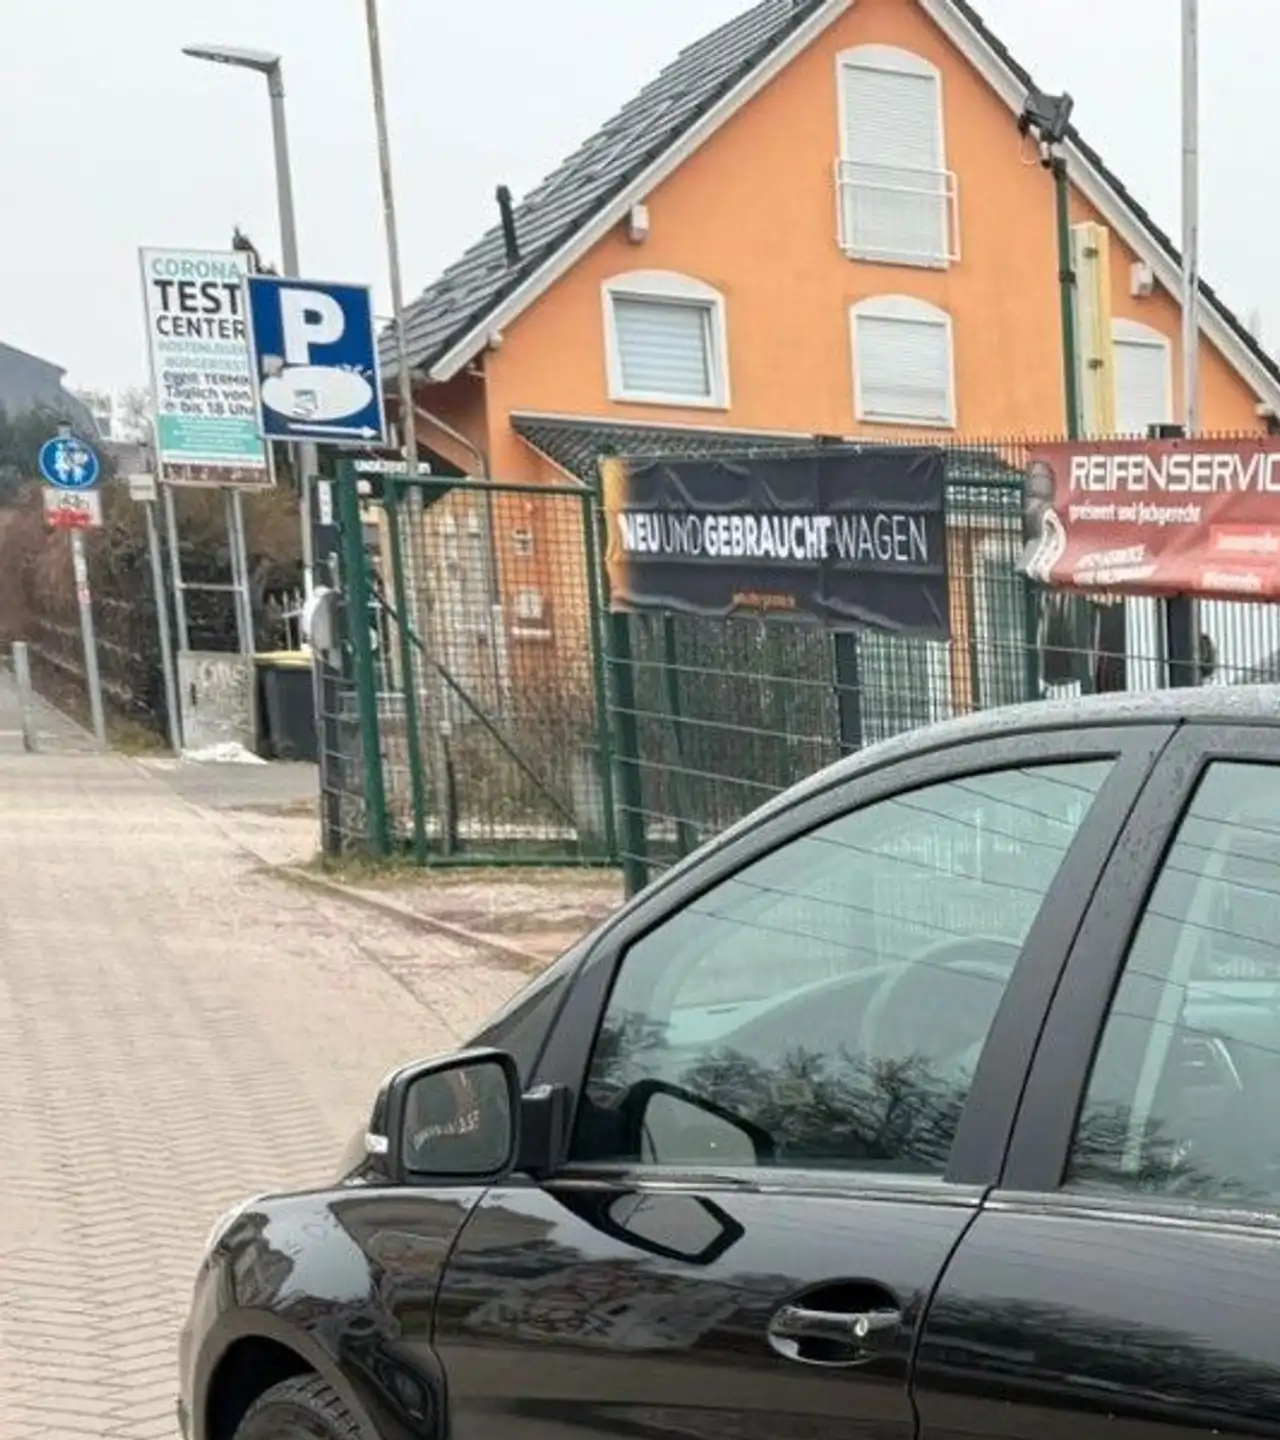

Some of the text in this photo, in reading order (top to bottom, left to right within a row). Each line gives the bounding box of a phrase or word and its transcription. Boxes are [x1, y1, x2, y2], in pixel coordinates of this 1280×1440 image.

[152, 257, 241, 279] CORONA
[153, 280, 241, 315] TEST
[156, 315, 246, 339] CENTER
[279, 287, 345, 364] P
